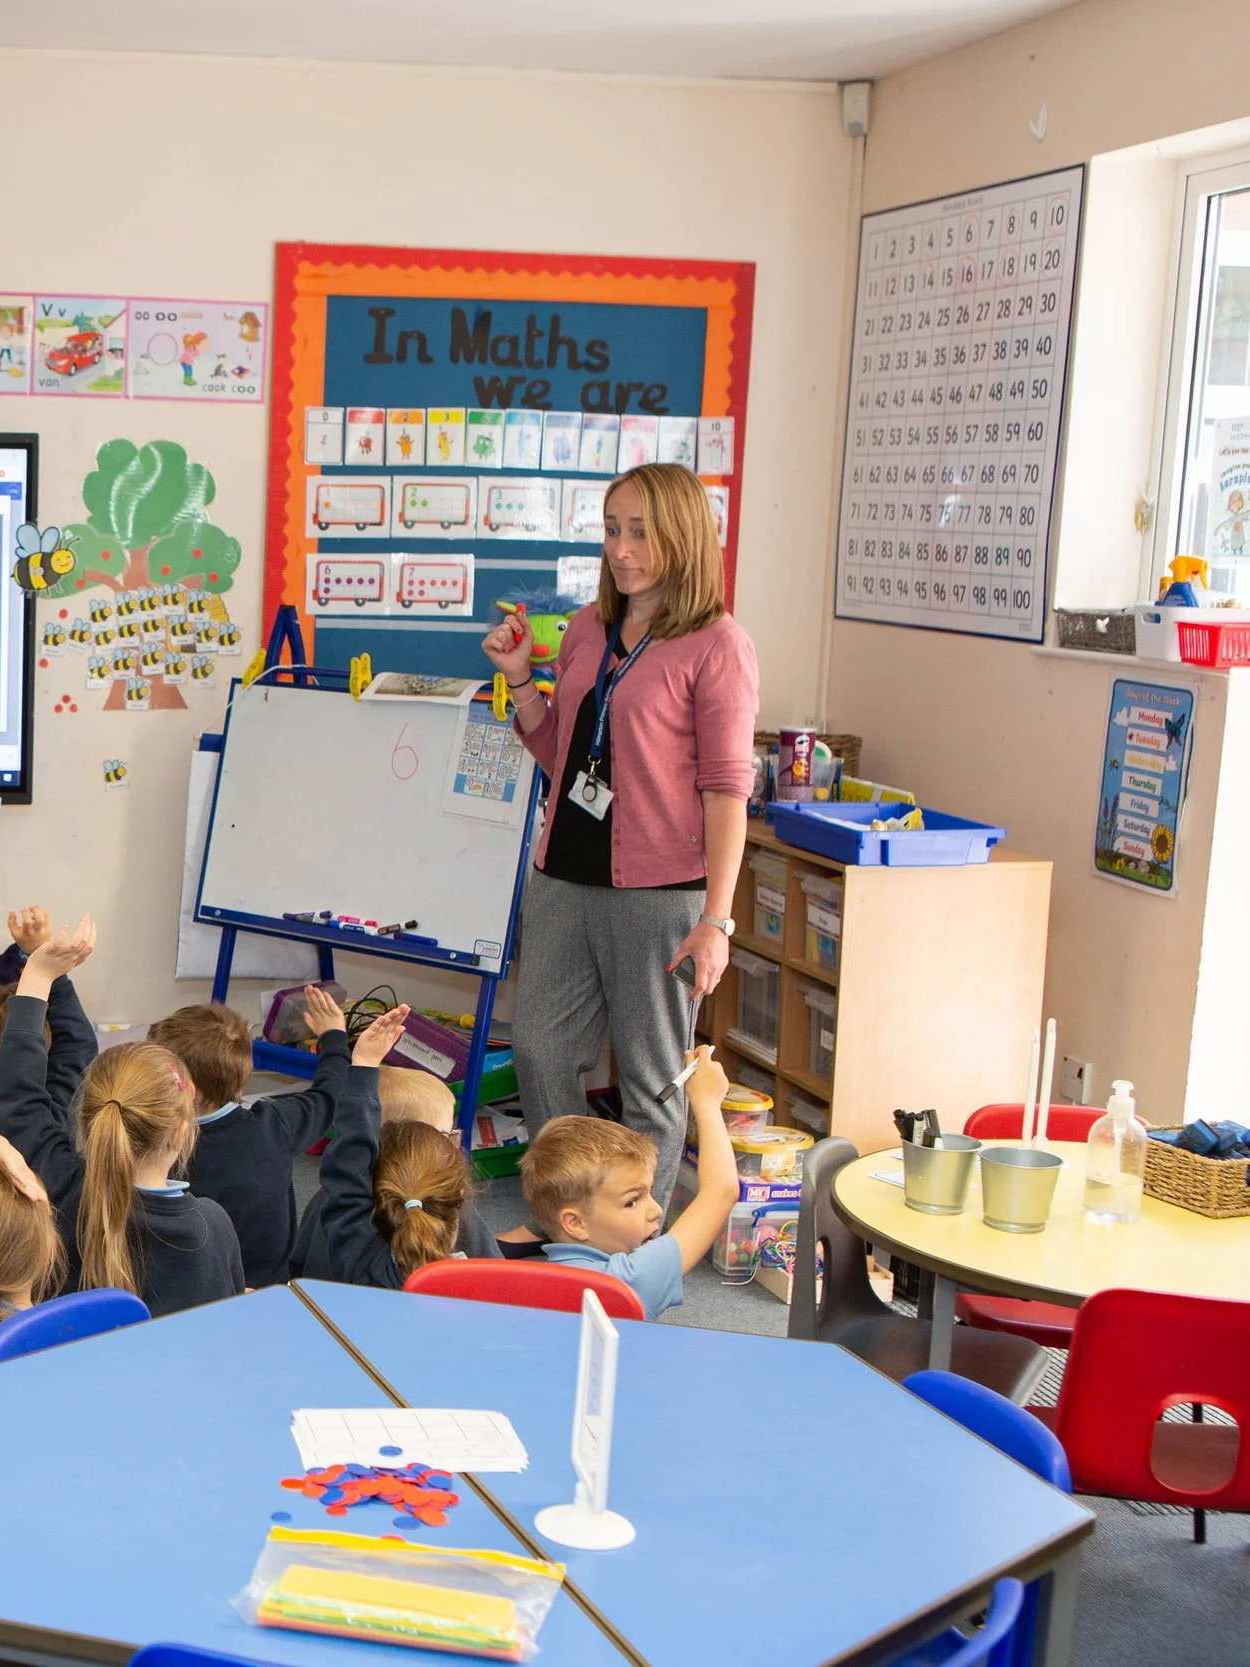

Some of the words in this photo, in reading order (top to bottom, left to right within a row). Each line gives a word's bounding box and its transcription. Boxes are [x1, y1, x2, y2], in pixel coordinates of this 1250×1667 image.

[874, 244, 878, 260] 1
[891, 240, 896, 258] 2
[909, 236, 915, 254] 3
[928, 233, 934, 249] 4
[947, 228, 953, 247] 5
[966, 224, 972, 242] 6
[988, 220, 994, 239] 7
[1008, 215, 1015, 234] 8
[1030, 211, 1037, 230] 9
[1051, 205, 1064, 225] 10
[42, 304, 53, 316] V
[58, 308, 66, 317] v
[363, 307, 434, 364] In
[450, 306, 610, 374] Maths
[39, 377, 60, 387] van
[473, 375, 553, 409] we
[580, 378, 670, 414] are
[859, 394, 868, 408] 41
[875, 392, 887, 408] 42
[893, 390, 905, 407] 43
[911, 389, 923, 405] 44
[930, 387, 942, 404] 45
[950, 386, 962, 403] 46
[969, 384, 982, 401] 47
[989, 382, 1003, 401] 48
[1010, 381, 1024, 399] 49
[1032, 379, 1047, 398] 50
[323, 412, 329, 422] 0
[444, 411, 451, 422] 3
[712, 422, 721, 431] 10
[411, 487, 418, 497] 2
[324, 567, 331, 576] 6
[409, 568, 416, 577] 7
[847, 576, 856, 592] 91
[863, 577, 874, 594] 92
[880, 578, 891, 596] 93
[897, 579, 908, 597] 94
[915, 581, 927, 599] 95
[934, 582, 946, 601] 96
[953, 584, 965, 602] 97
[973, 586, 986, 605] 98
[994, 588, 1007, 606] 99
[1013, 590, 1030, 609] 100
[1126, 688, 1142, 701] Days
[1142, 691, 1150, 703] of
[1164, 693, 1181, 706] Week
[1139, 711, 1164, 728] Monday
[1136, 733, 1160, 749] Tuesday
[391, 723, 418, 780] 6
[1129, 773, 1156, 794] Thursday
[1130, 798, 1150, 814] Friday
[1124, 819, 1150, 837] Saturday
[1123, 839, 1144, 857] Sunday
[771, 1189, 799, 1198] snakes
